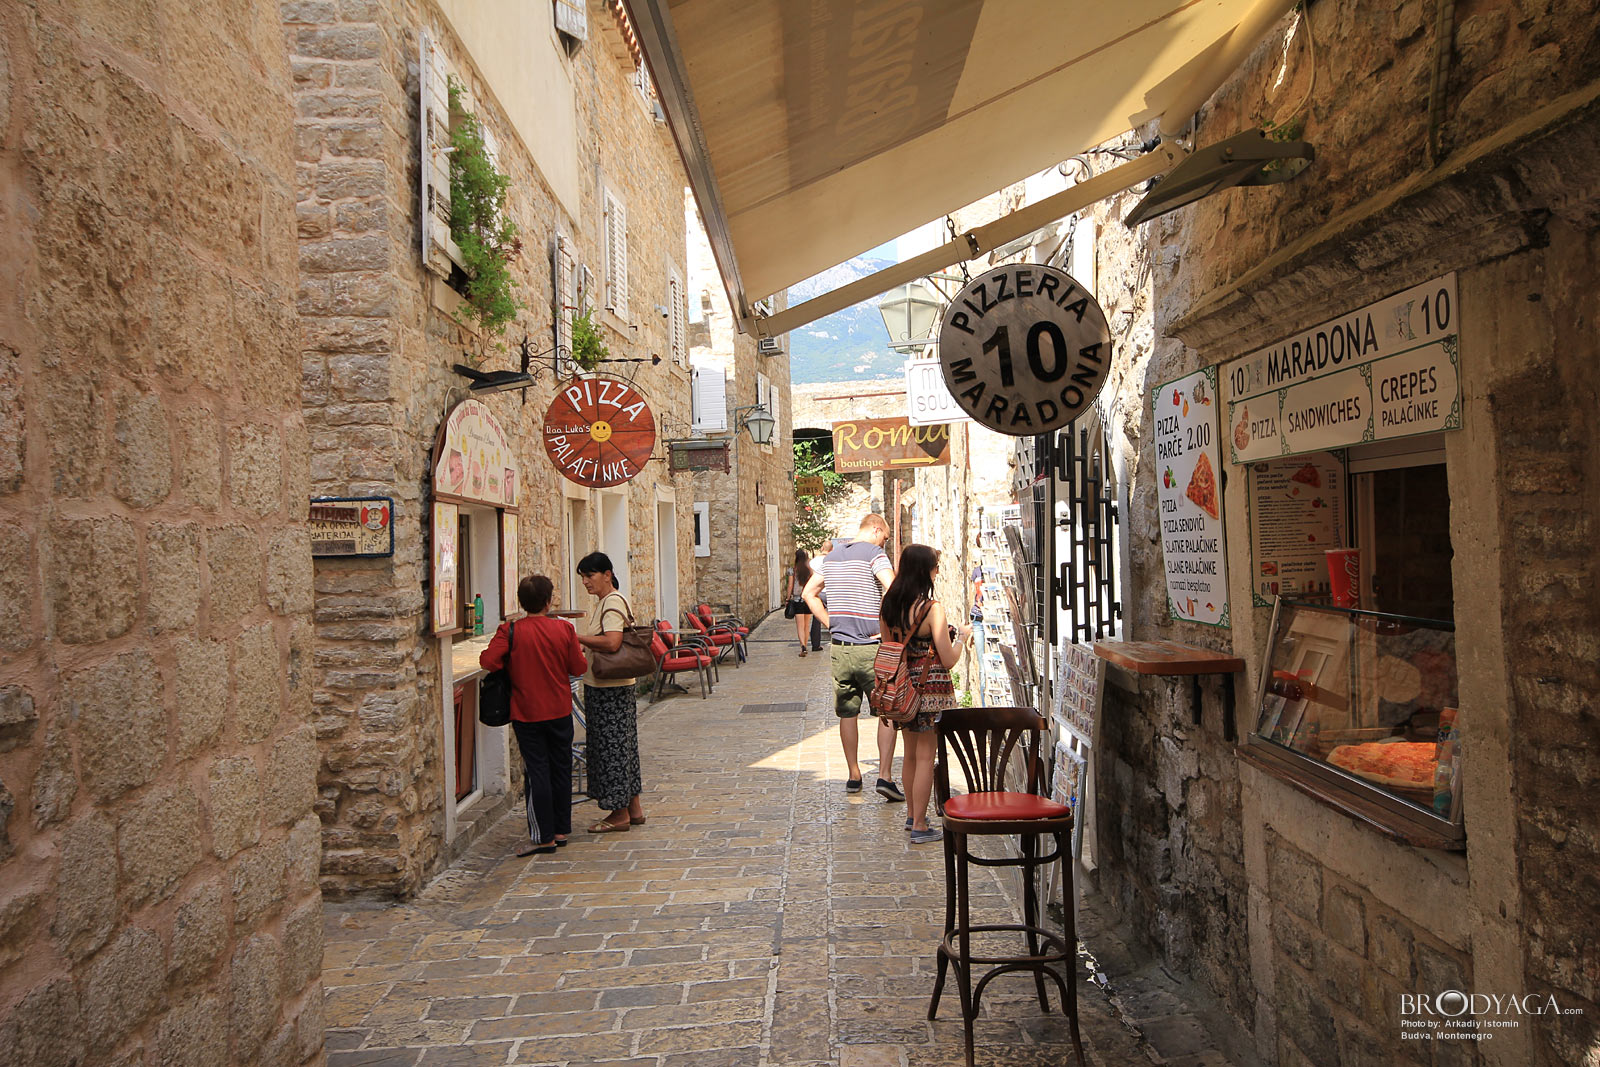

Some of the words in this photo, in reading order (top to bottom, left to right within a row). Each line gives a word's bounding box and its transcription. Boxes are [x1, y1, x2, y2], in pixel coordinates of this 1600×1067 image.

[951, 270, 1089, 335] PIZZERIA
[982, 320, 1068, 388] 10
[1230, 367, 1244, 397] 10
[1267, 312, 1379, 386] MARADONA
[1421, 288, 1450, 334] 10
[950, 341, 1102, 426] MARADONA
[1380, 366, 1437, 403] CREPES
[566, 380, 646, 422] PIZZA
[1288, 396, 1361, 433] SANDWICHES
[1382, 399, 1439, 427] PALAČINKE
[1157, 415, 1179, 437] PIZZA
[1187, 422, 1210, 451] 2.00
[1251, 417, 1277, 441] PIZZA
[1158, 434, 1182, 460] PARČE
[840, 457, 884, 469] boutique
[1162, 499, 1177, 513] PIZZA
[1163, 520, 1178, 533] PIZZA
[1165, 539, 1185, 553] SLATKE
[1185, 536, 1218, 553] PALAČINKE
[1167, 560, 1184, 574] SLANE
[1185, 557, 1217, 575] PALAČINKE
